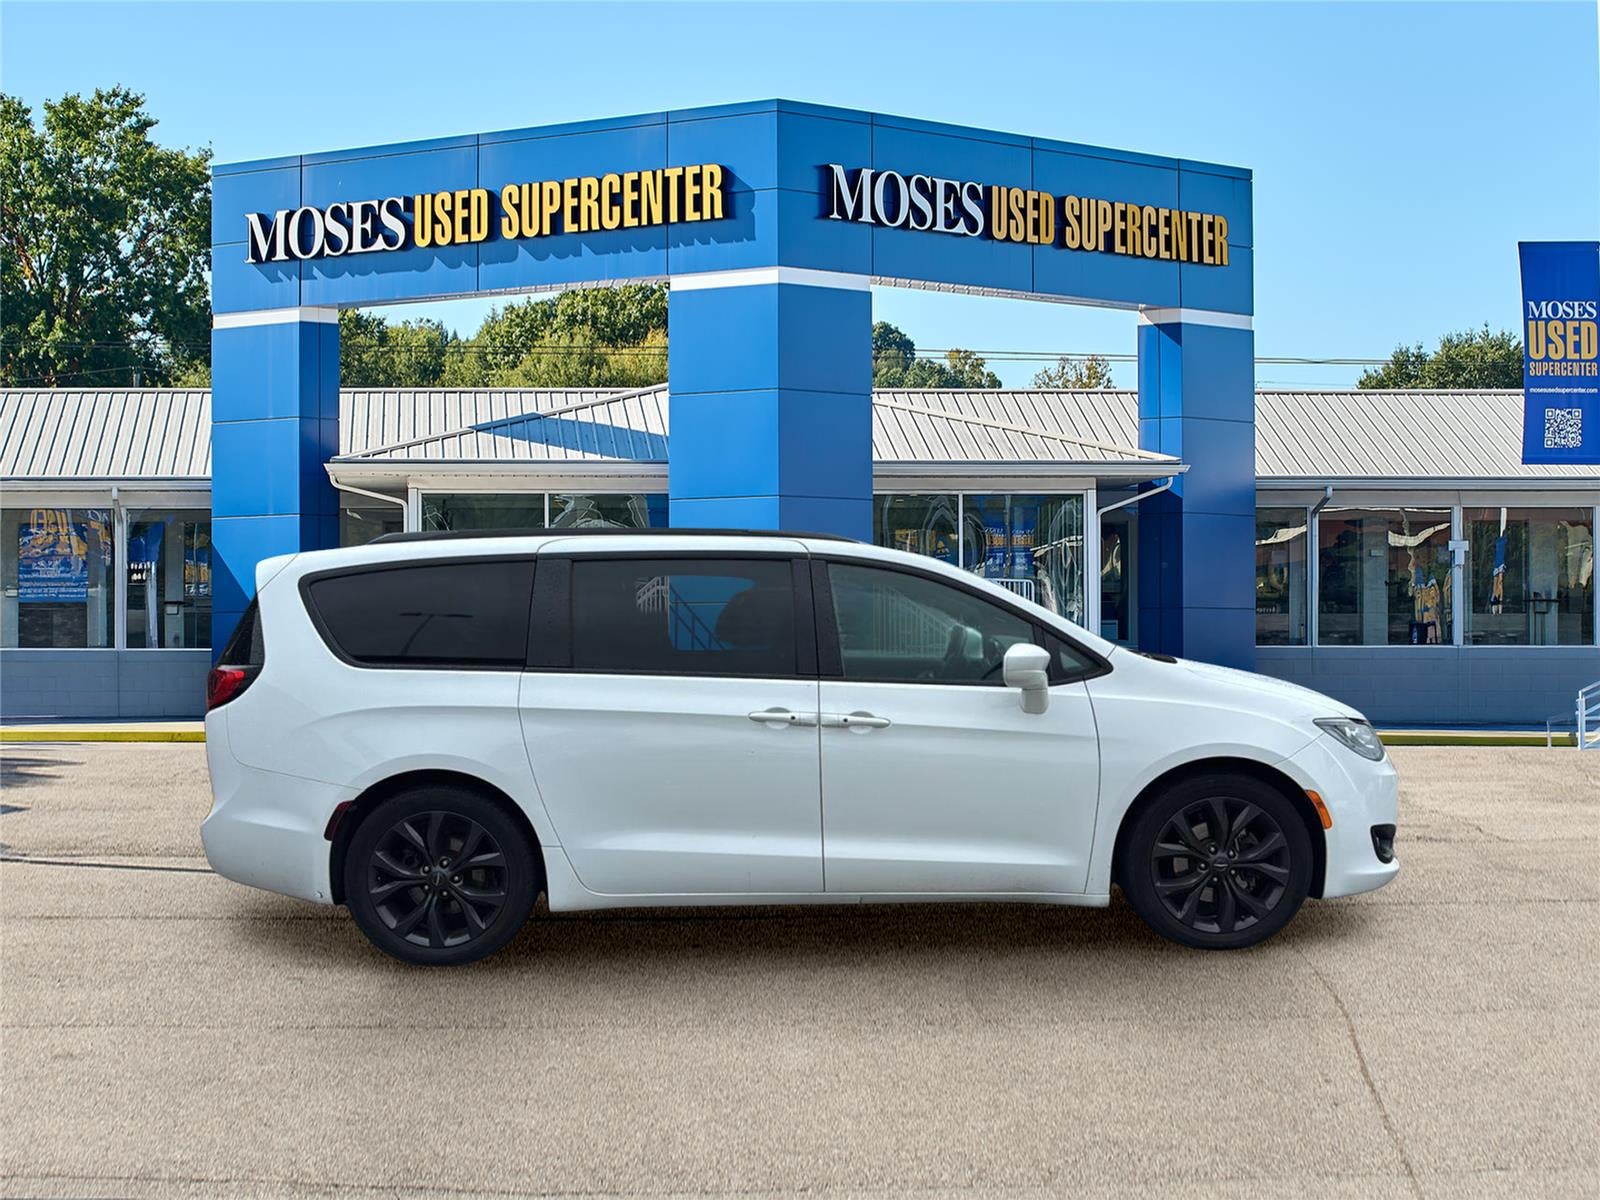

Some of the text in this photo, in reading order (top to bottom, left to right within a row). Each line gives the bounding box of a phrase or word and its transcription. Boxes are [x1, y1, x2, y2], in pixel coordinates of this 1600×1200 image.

[244, 163, 725, 264] MOSES USED SUPERCENTER
[828, 163, 1229, 266] MOSES USED SUPERCENTER
[1527, 300, 1598, 319] MOSES
[1528, 320, 1598, 360] USED
[1529, 361, 1598, 377] SUPERCENTER
